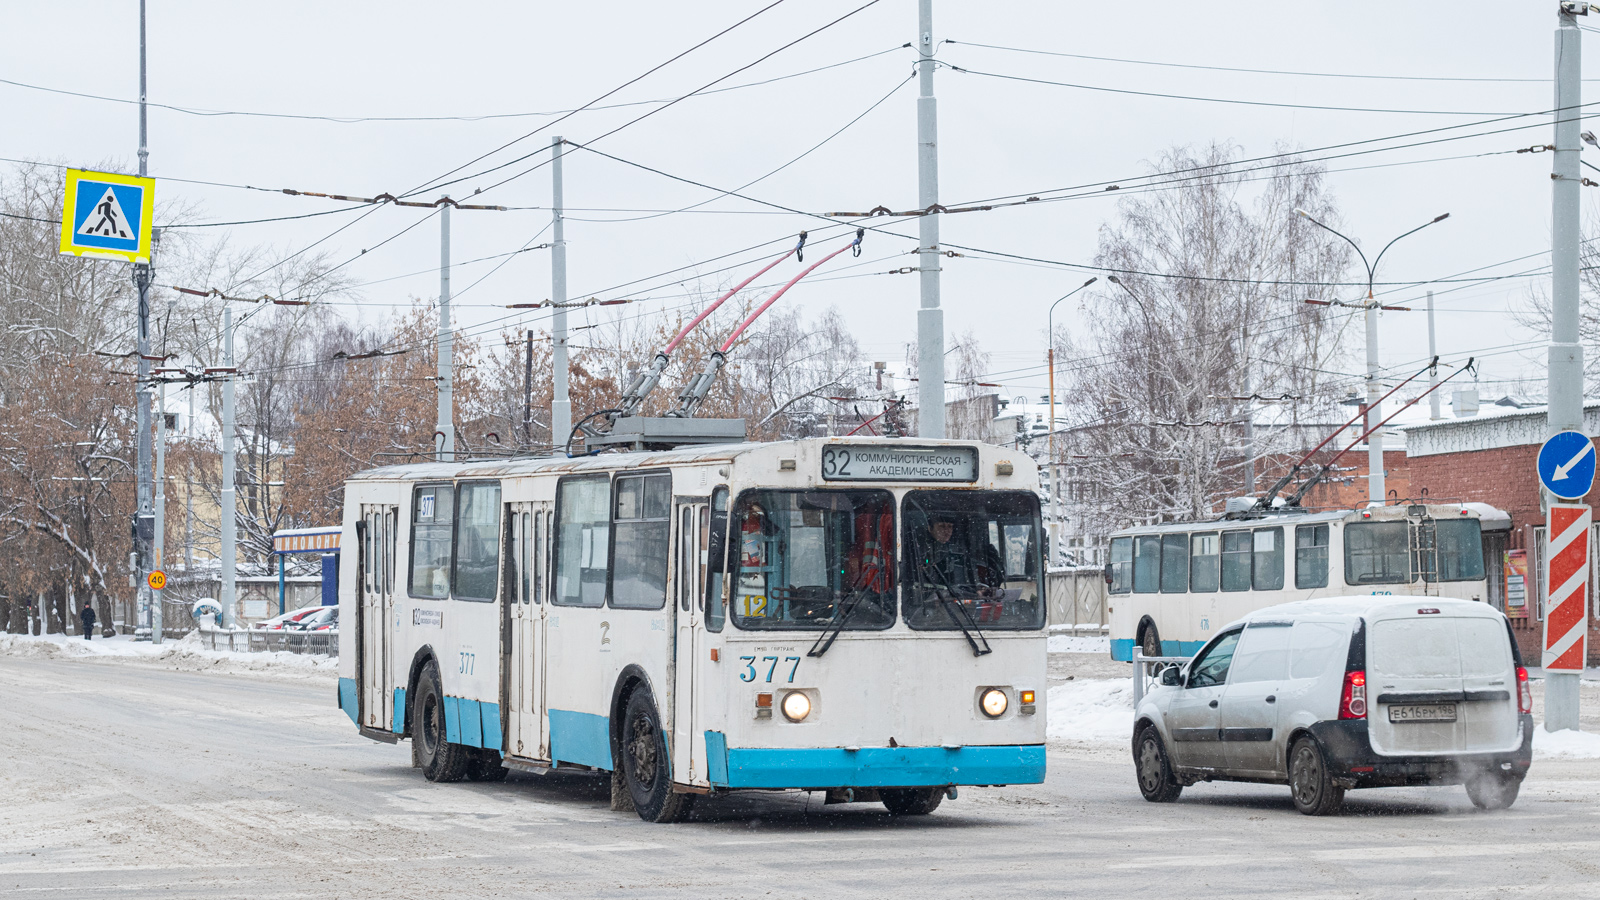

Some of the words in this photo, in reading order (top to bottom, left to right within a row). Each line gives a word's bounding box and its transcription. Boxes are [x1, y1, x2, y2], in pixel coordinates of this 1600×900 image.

[824, 450, 851, 476] 32
[855, 453, 961, 465] КОММУНИСТИЧЕСКАЯ
[869, 465, 954, 477] АКАДЕМИЧЕСКАЯ
[422, 496, 434, 516] 377
[151, 576, 163, 584] 40
[743, 595, 767, 618] 12
[460, 652, 475, 675] 377
[739, 655, 801, 683] 377
